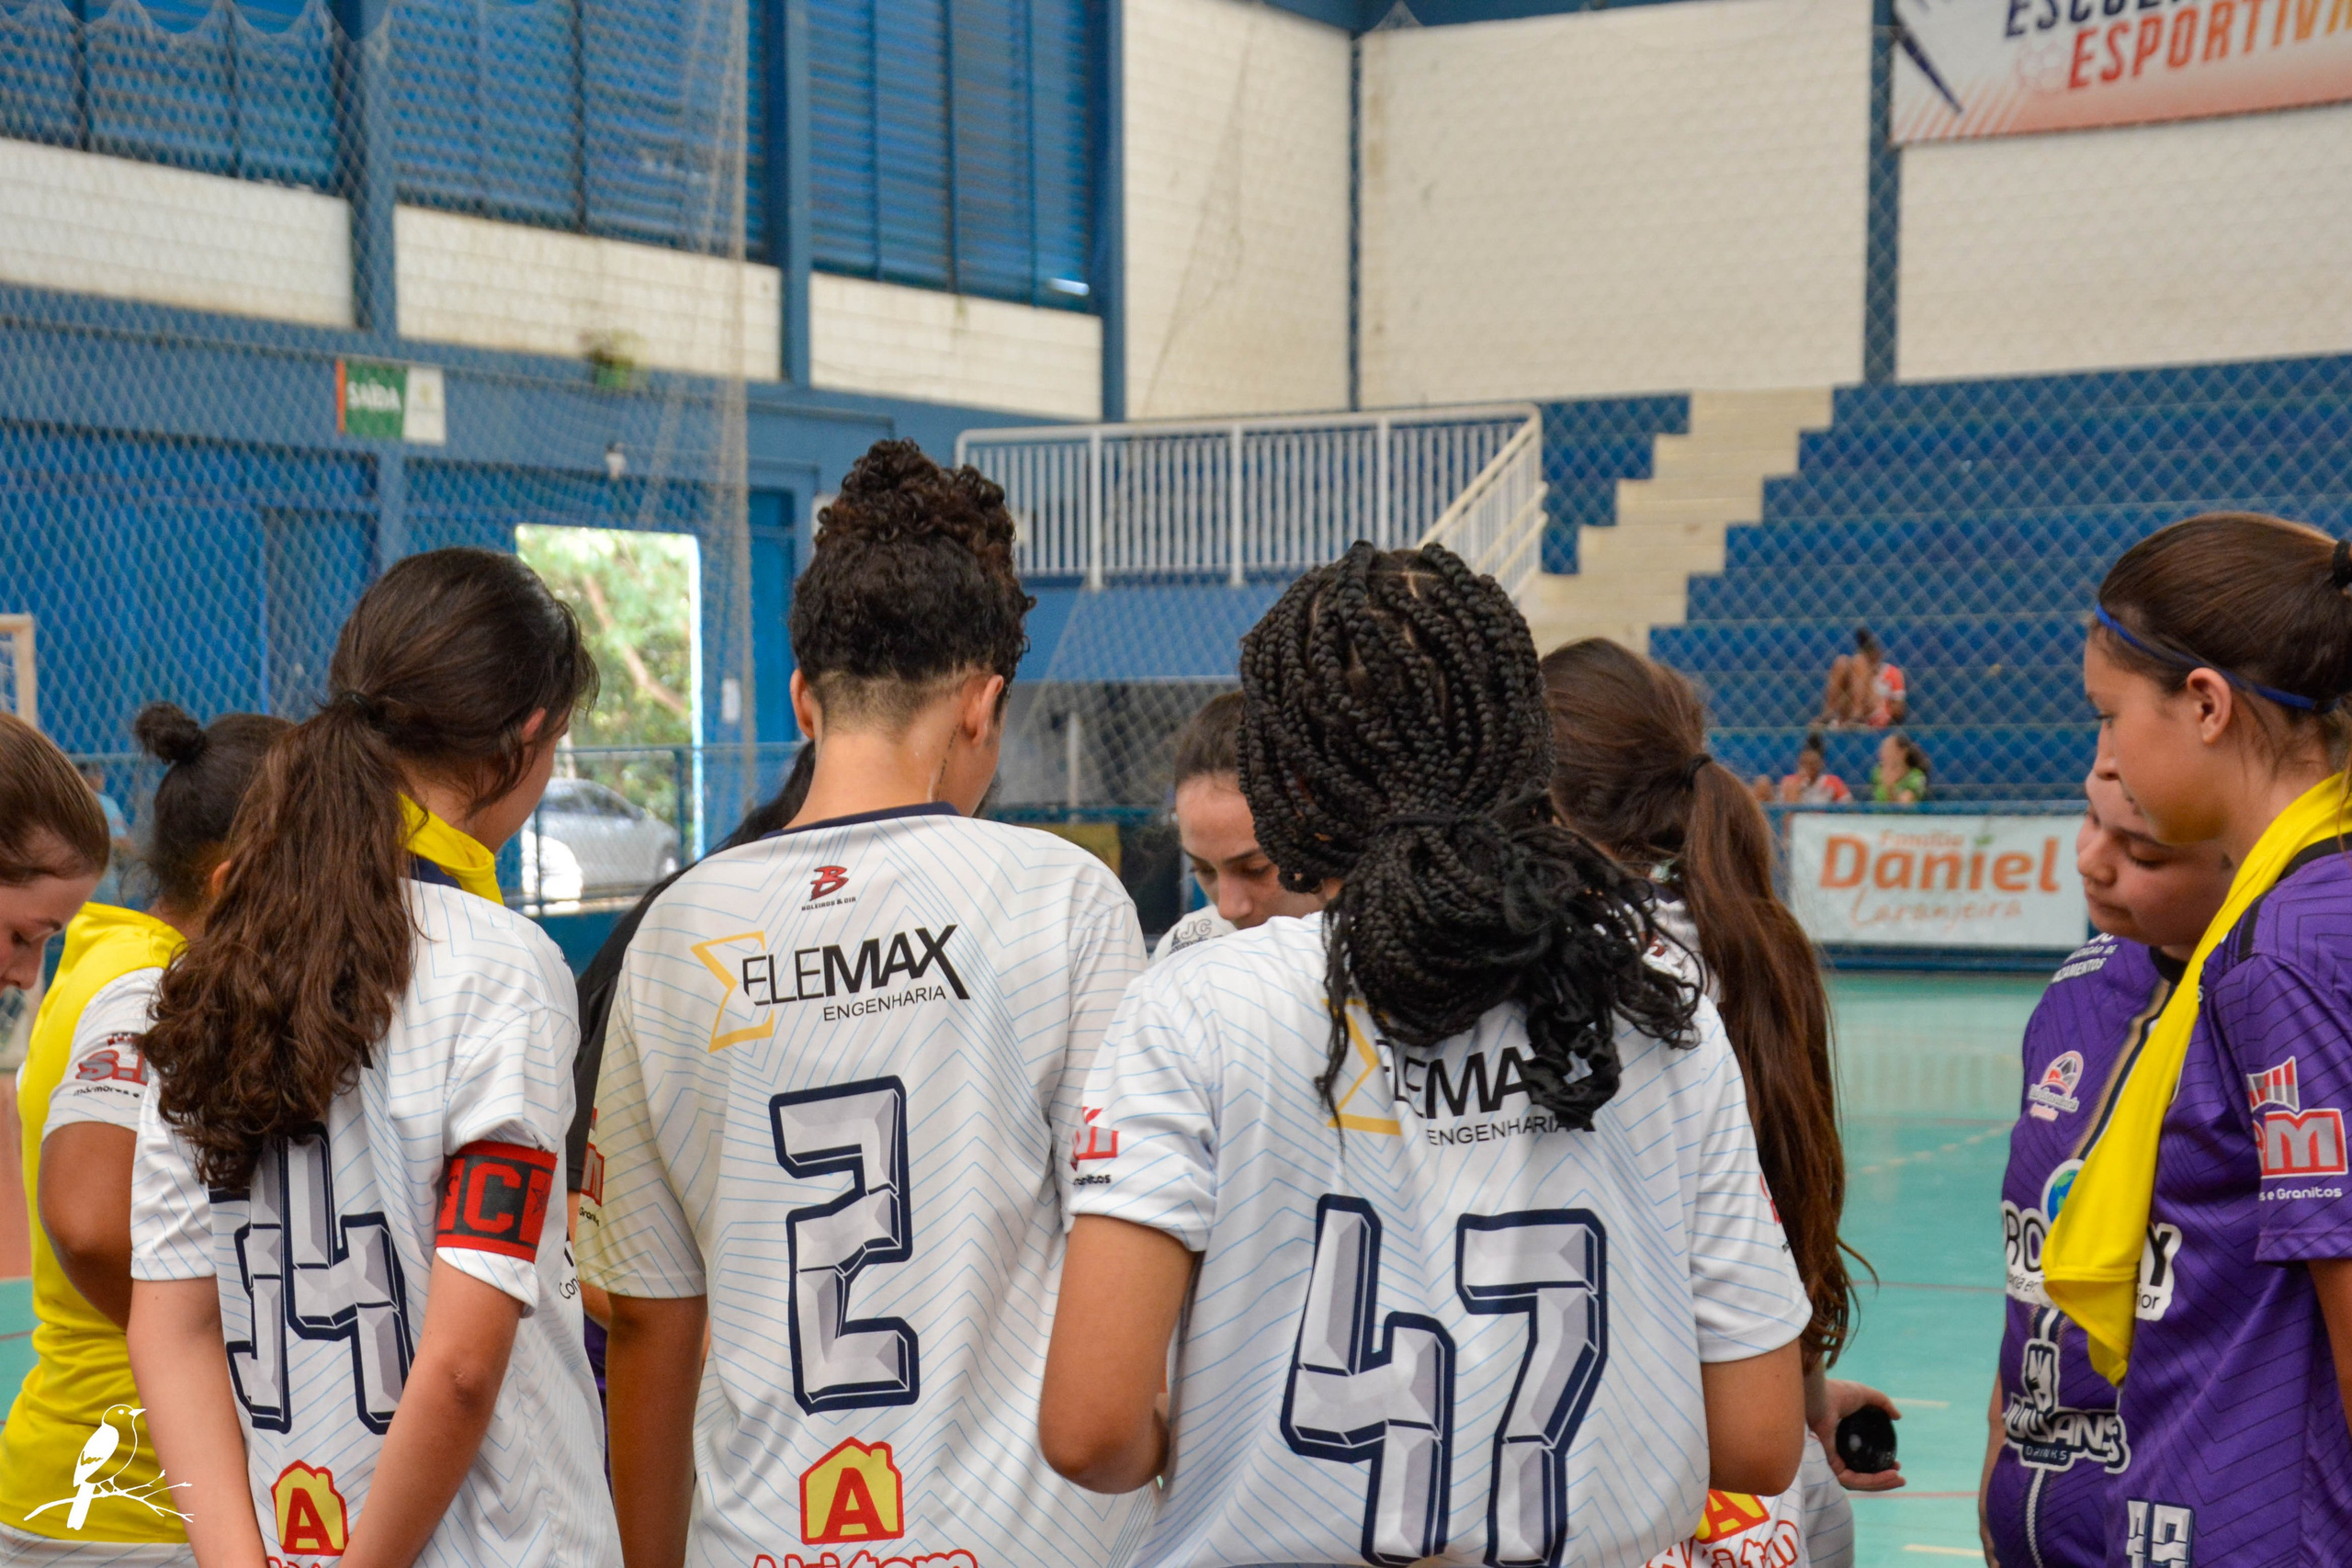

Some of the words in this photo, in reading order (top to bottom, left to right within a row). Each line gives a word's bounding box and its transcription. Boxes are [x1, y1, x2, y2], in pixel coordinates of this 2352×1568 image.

[1820, 835, 2062, 893] Daniel
[742, 924, 970, 1007] ELEMAX
[823, 986, 947, 1021] ENGENHARIA
[463, 1162, 522, 1234] C
[2276, 1186, 2343, 1201] Granitos
[769, 1075, 920, 1416] 2
[1280, 1193, 1608, 1568] 47
[283, 1487, 337, 1552] A
[820, 1467, 889, 1540] A
